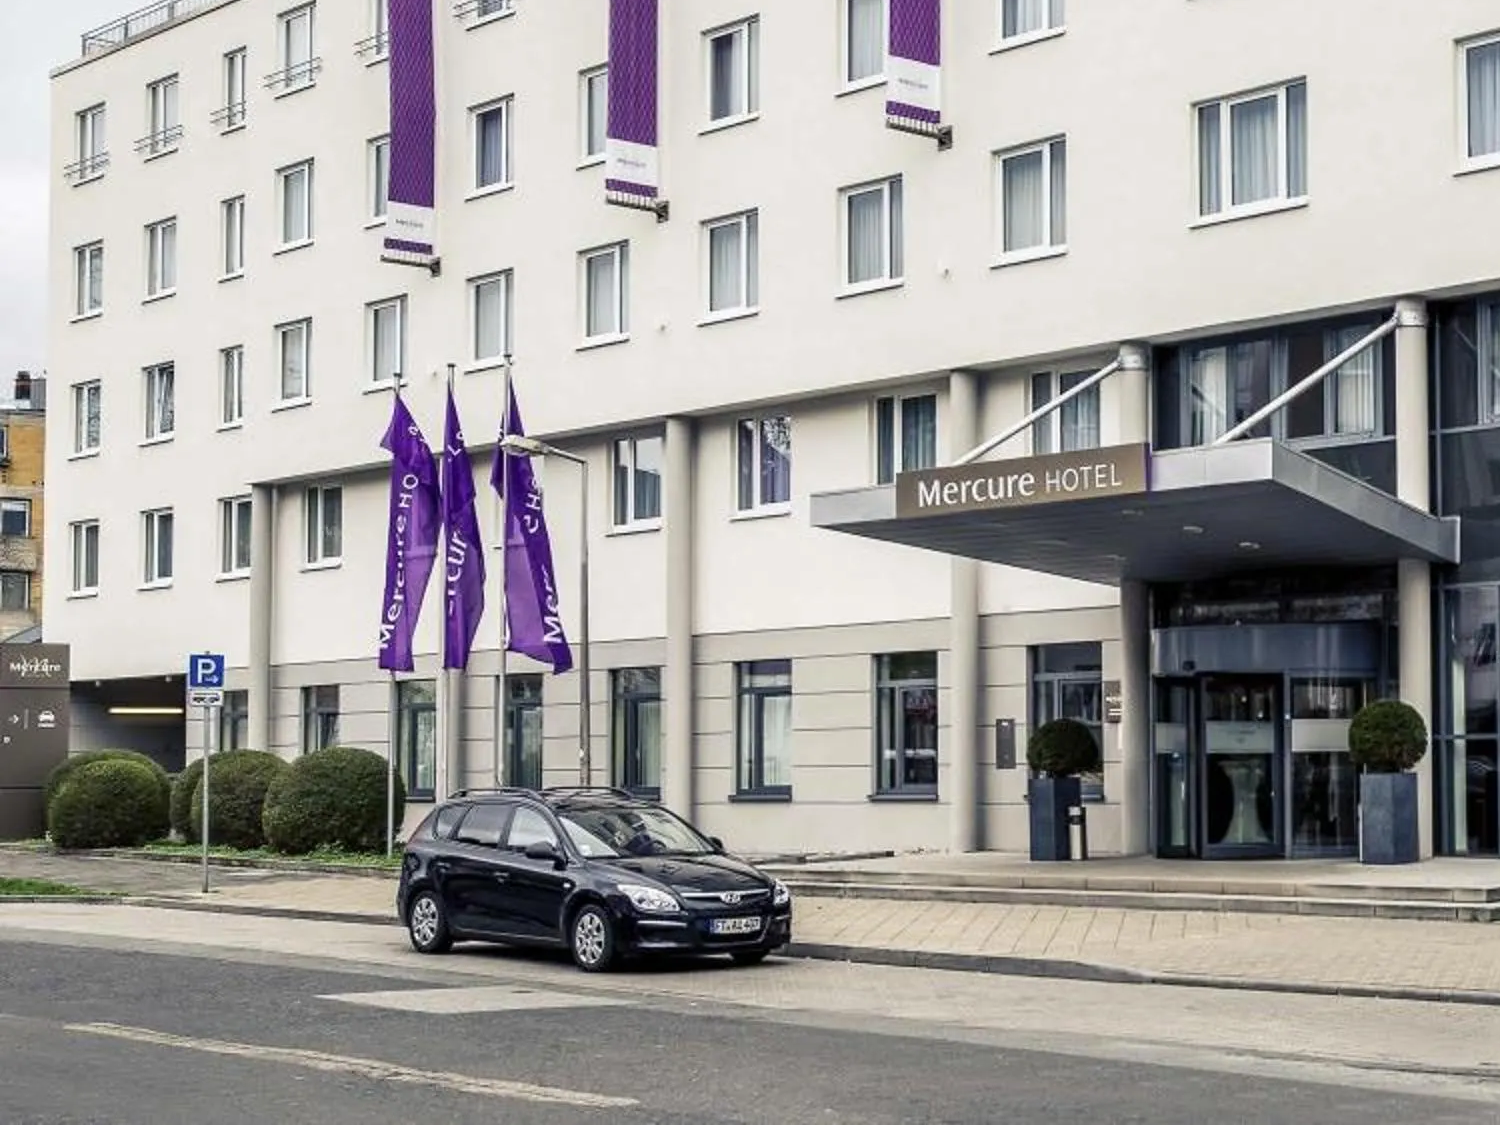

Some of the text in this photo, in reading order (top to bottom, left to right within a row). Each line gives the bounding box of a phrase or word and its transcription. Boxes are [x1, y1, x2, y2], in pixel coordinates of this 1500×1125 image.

[917, 462, 1122, 508] Mercure HOTEL
[197, 658, 217, 684] P
